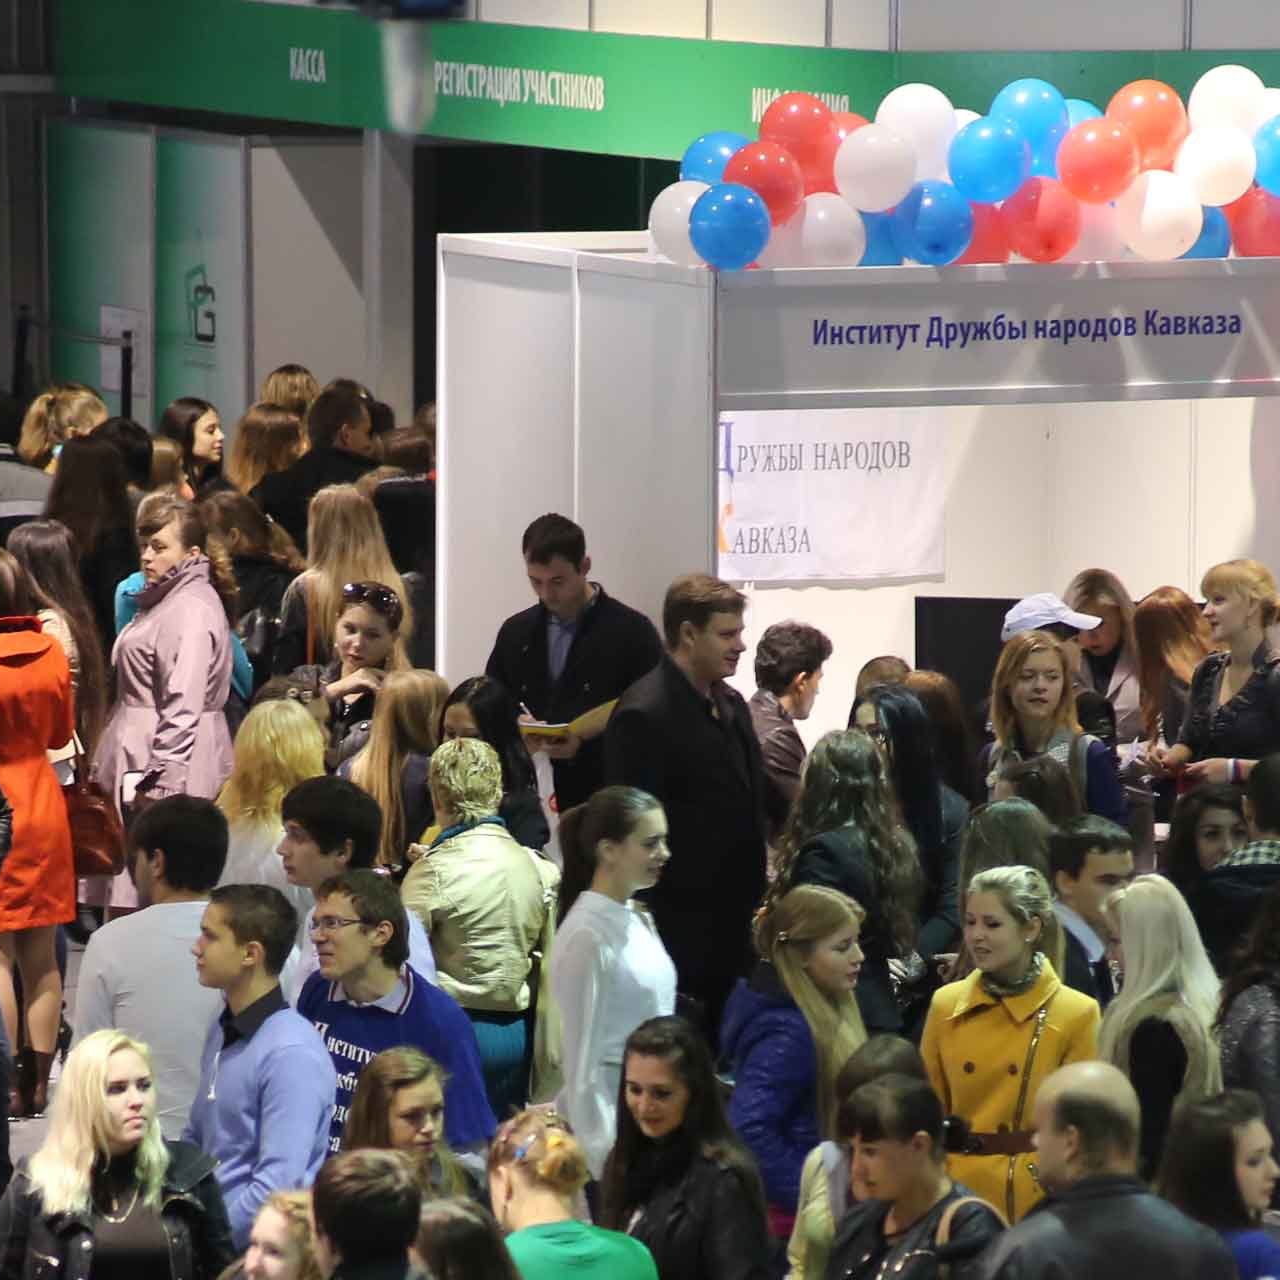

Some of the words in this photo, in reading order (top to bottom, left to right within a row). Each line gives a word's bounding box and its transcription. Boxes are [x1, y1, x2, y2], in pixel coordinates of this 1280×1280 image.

[289, 47, 326, 83] КАССА
[434, 61, 521, 108] РЕГИСТРАЦИЯ
[521, 69, 605, 111] УЧАСТНИКОВ
[813, 319, 920, 348] Институт
[926, 313, 1026, 349] Дружбы
[1033, 315, 1137, 346] народов
[1143, 310, 1241, 336] Кавказа
[813, 440, 912, 473] НАРОДОВ
